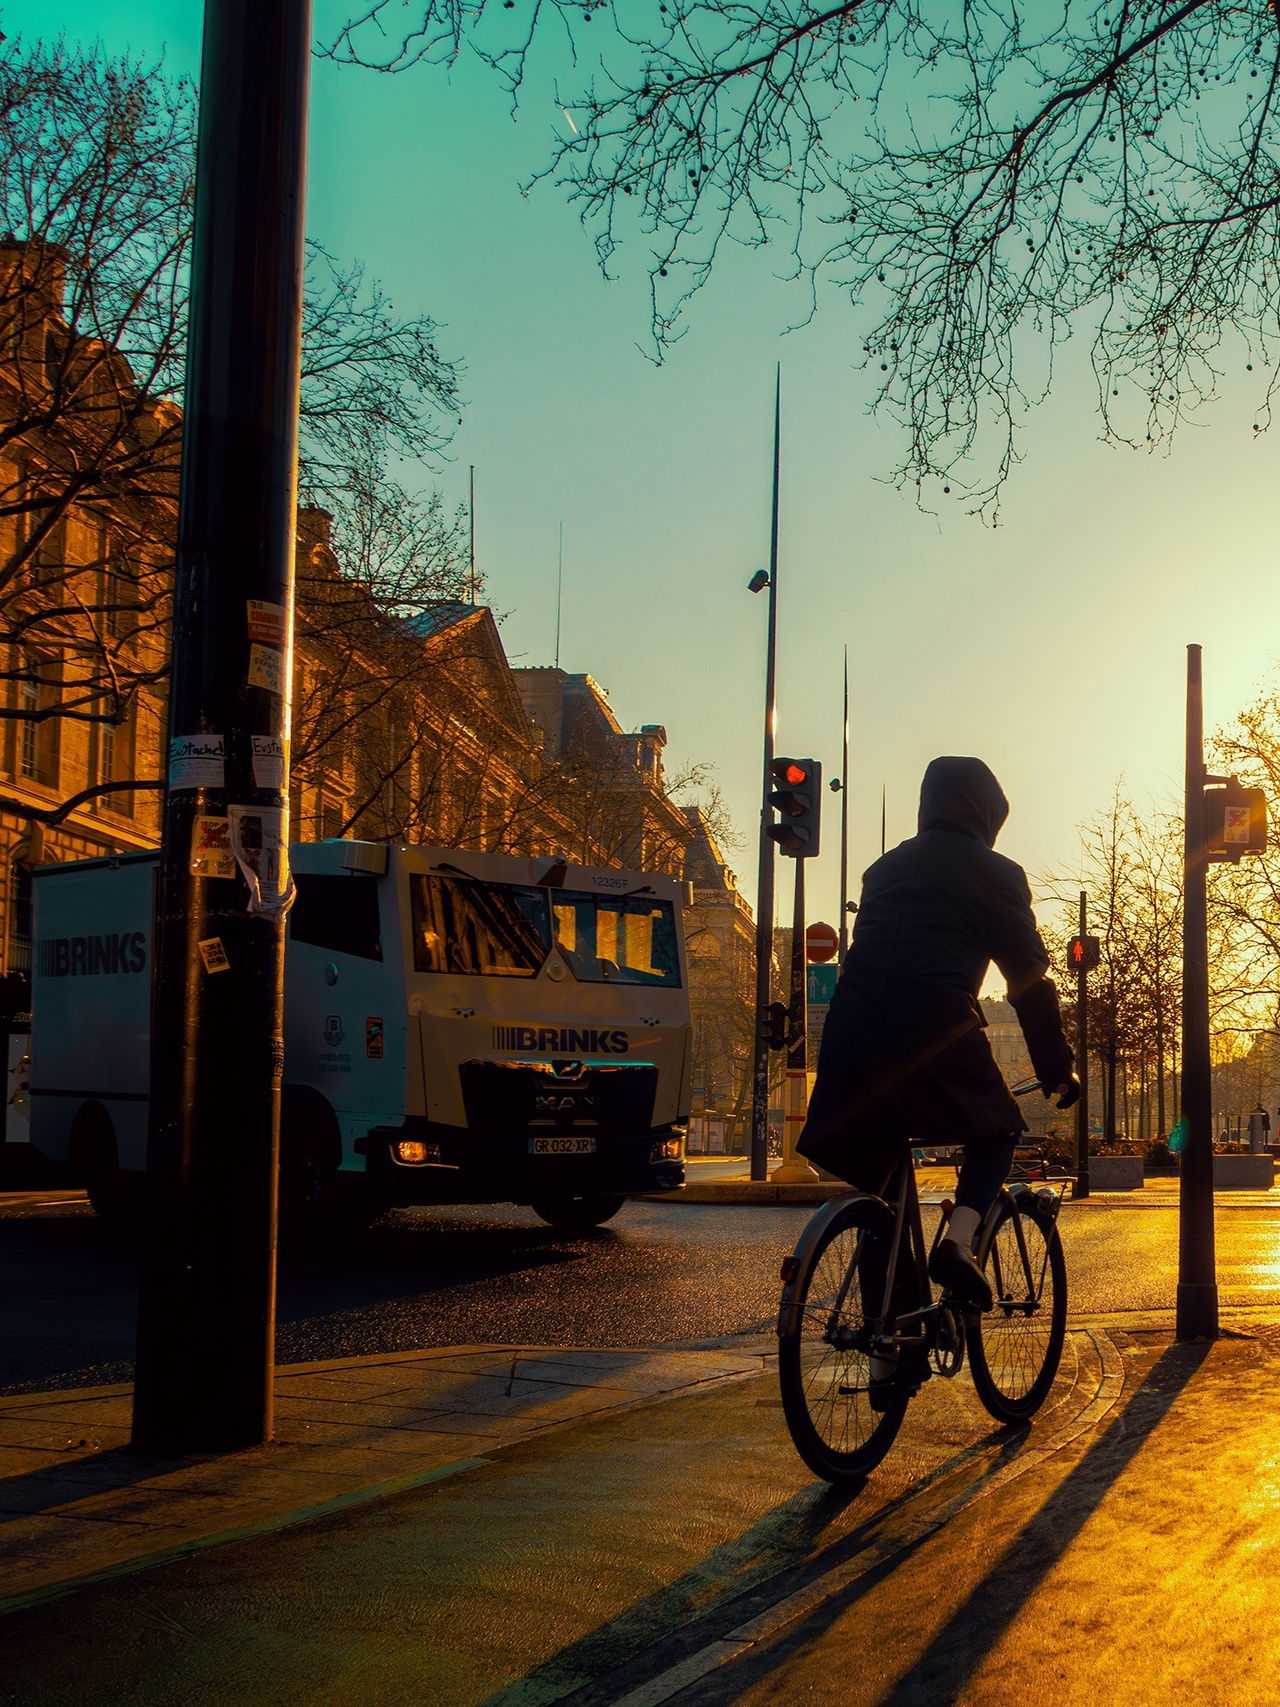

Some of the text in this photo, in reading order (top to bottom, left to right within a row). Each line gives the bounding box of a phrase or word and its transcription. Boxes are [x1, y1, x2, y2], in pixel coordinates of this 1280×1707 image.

[55, 931, 147, 977] BRINKS
[516, 1027, 629, 1054] BRINKS
[535, 1096, 600, 1112] MAN
[534, 1139, 590, 1153] GR-032-XR
